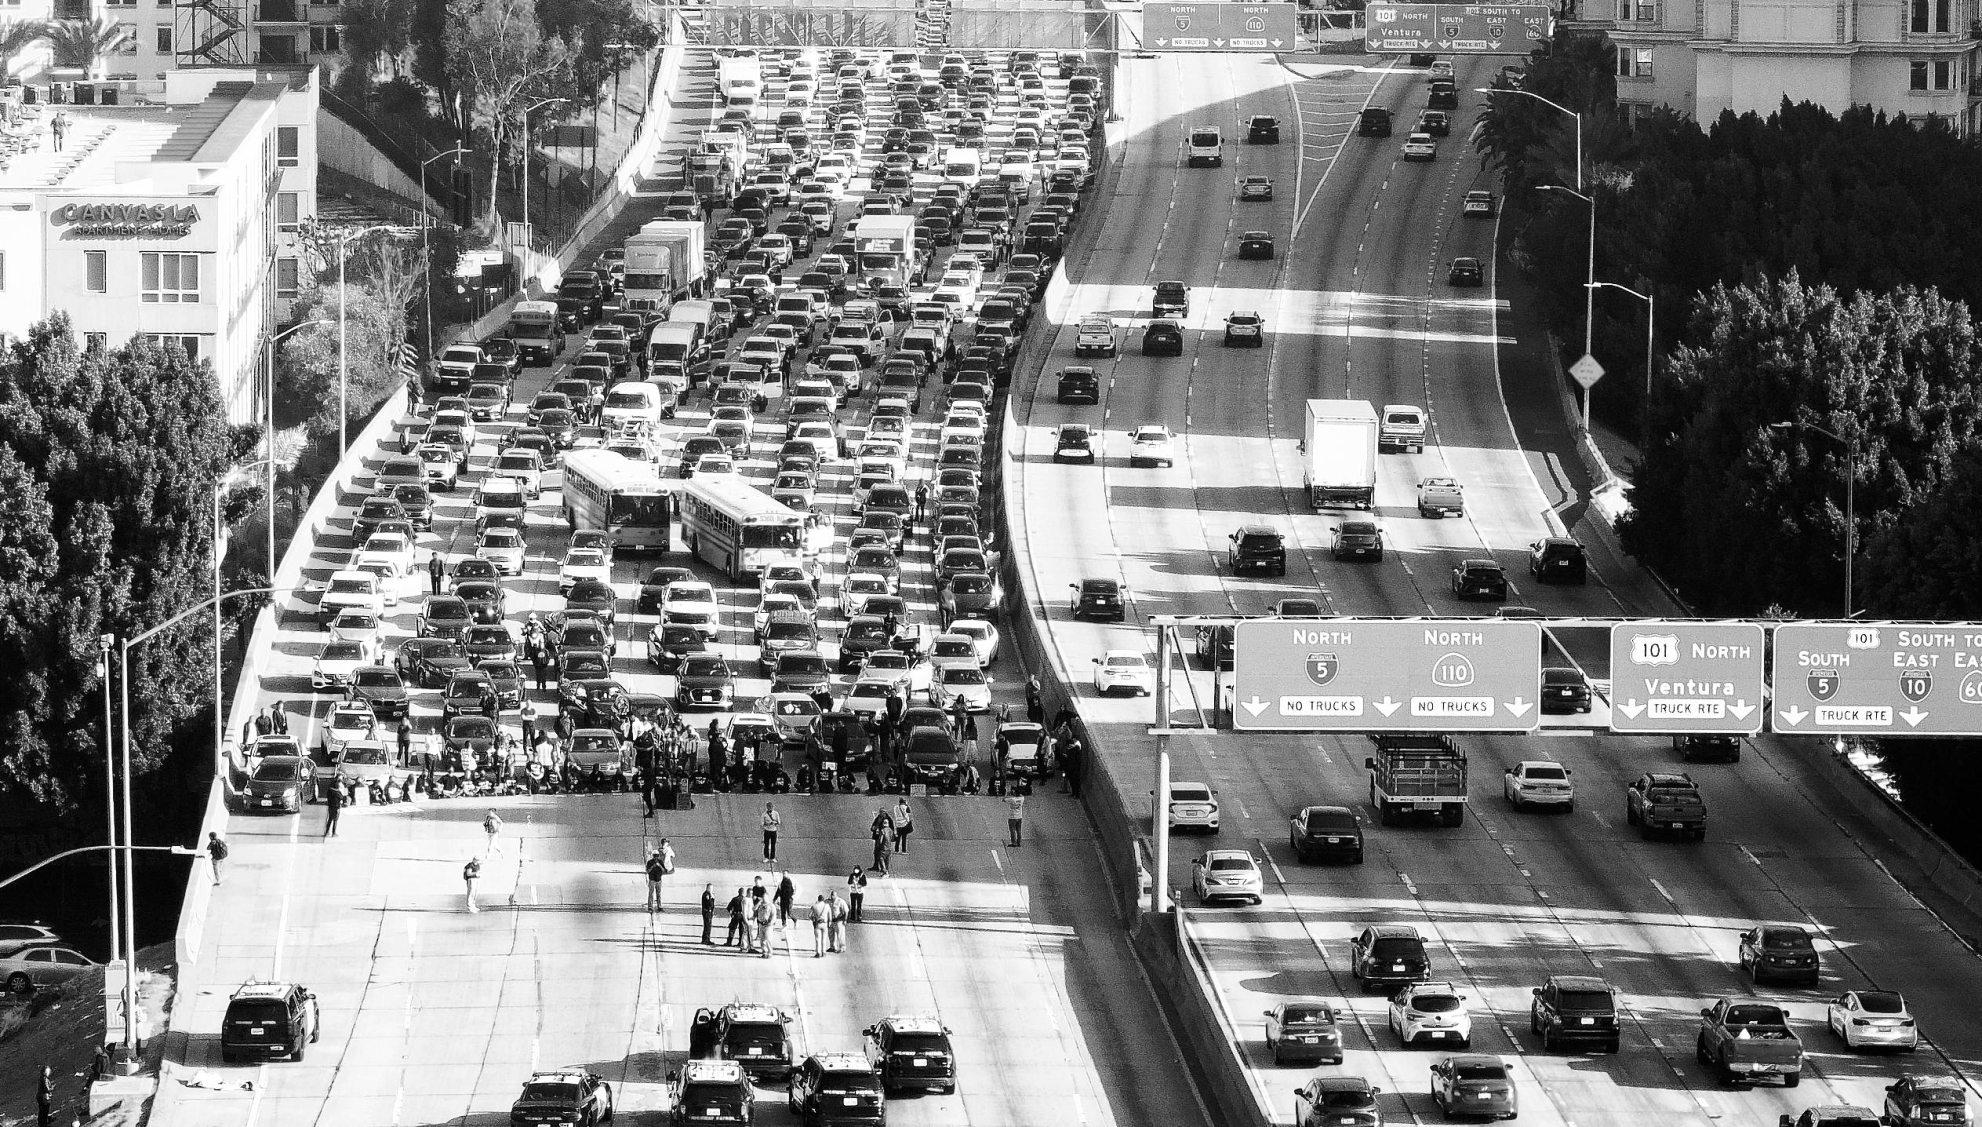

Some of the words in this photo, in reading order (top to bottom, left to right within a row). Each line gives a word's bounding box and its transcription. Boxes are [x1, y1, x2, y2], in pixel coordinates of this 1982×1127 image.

[1180, 20, 1186, 28] 5
[1380, 12, 1393, 20] 101
[1249, 21, 1261, 29] 110
[1381, 28, 1421, 36] Ventura
[62, 203, 164, 221] CANVAS
[172, 203, 200, 221] LA
[1293, 629, 1352, 645] NORTH
[1424, 629, 1483, 646] NORTH
[1855, 633, 1873, 644] 101
[1898, 631, 1955, 647] SOUTH
[1964, 634, 1982, 647] TO
[1643, 643, 1667, 658] 101
[1692, 643, 1750, 659] NORTH
[1798, 651, 1850, 666] SOUTH
[1893, 651, 1940, 668] EAST
[1317, 662, 1328, 678] 5
[1440, 665, 1467, 681] 110
[1644, 679, 1734, 696] Ventura
[1818, 678, 1830, 694] 5
[1907, 679, 1926, 695] 10
[1287, 701, 1302, 711] NO
[1309, 701, 1356, 711] TRUCKS
[1418, 702, 1434, 711] NO
[1440, 702, 1487, 711] TRUCKS
[1654, 703, 1691, 714] TRUCK
[1698, 703, 1719, 714] RTE
[1821, 711, 1860, 720] TRUCK
[1866, 711, 1887, 721] RTE
